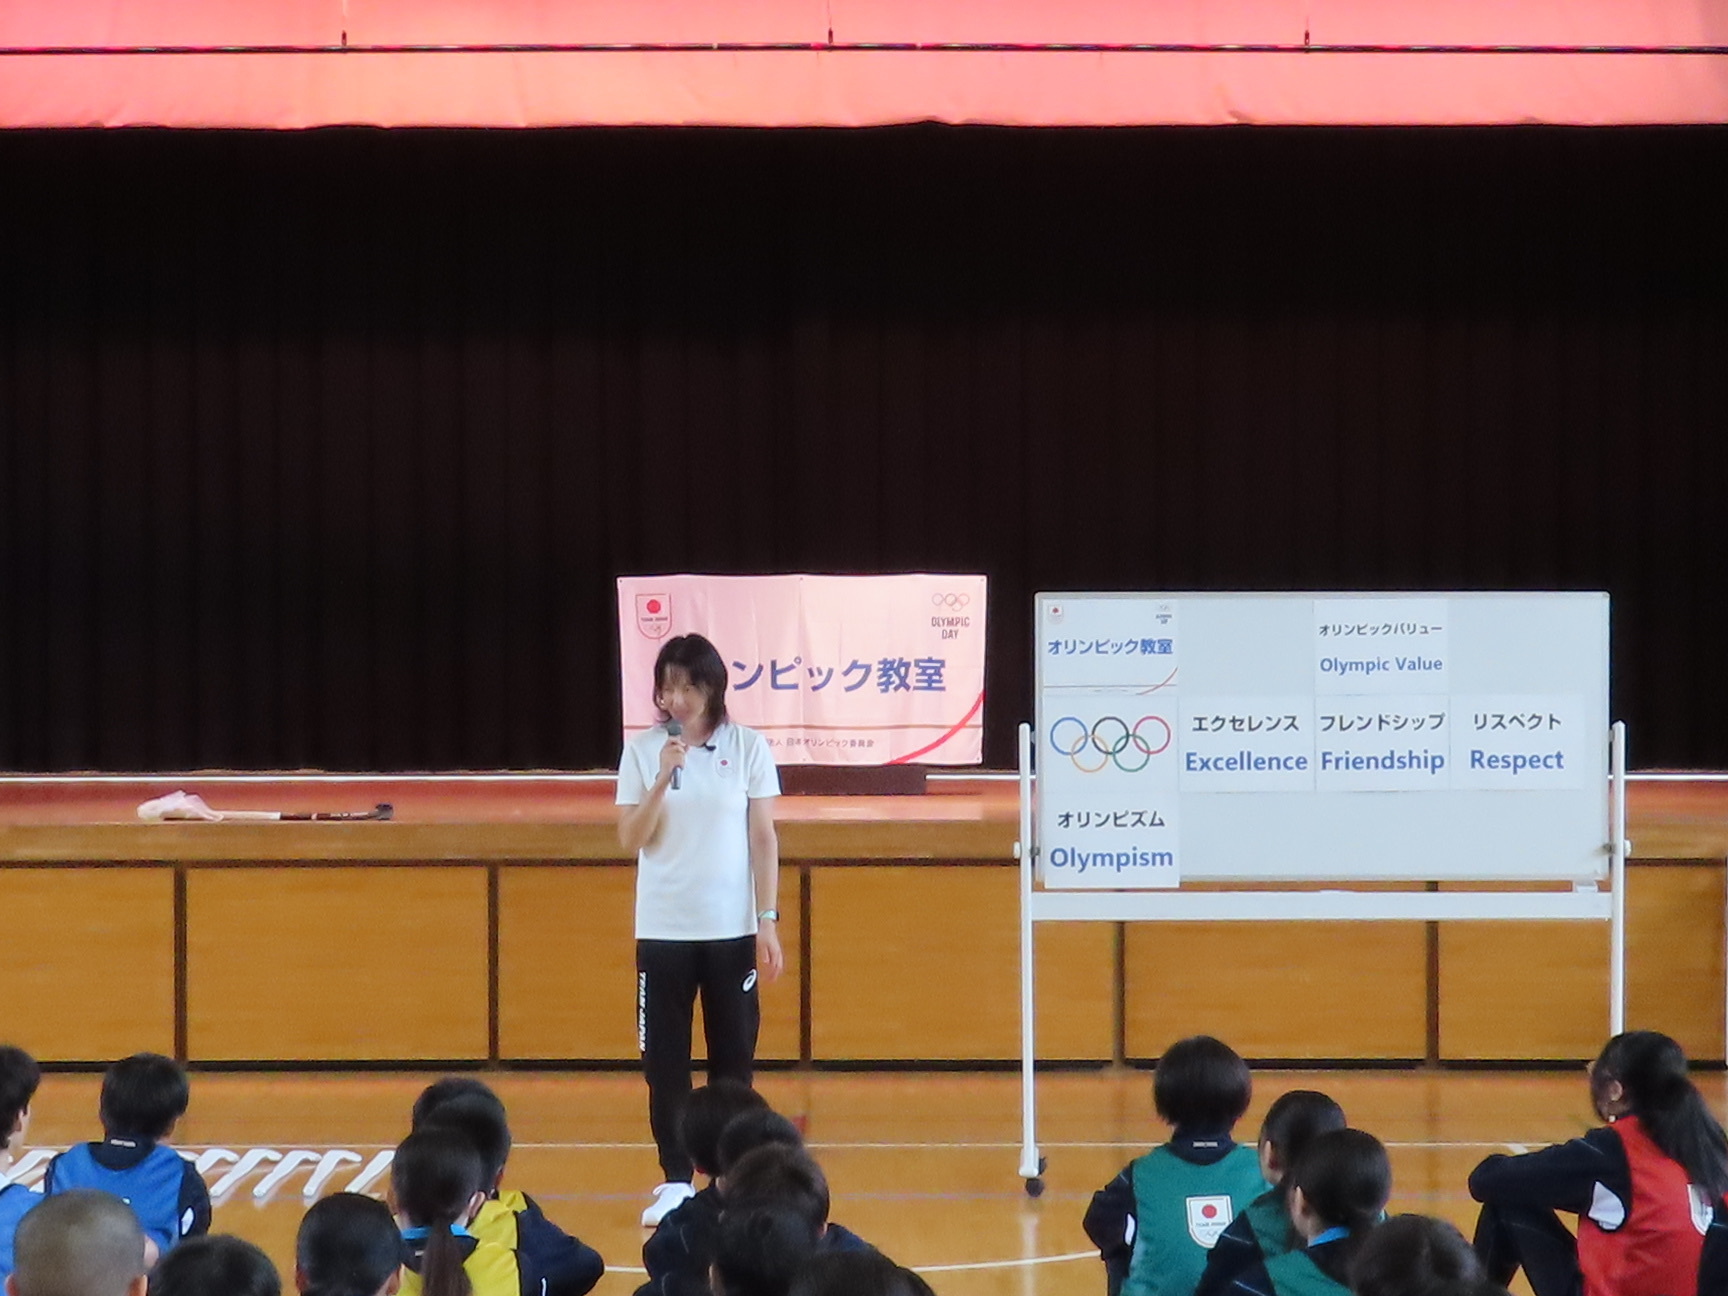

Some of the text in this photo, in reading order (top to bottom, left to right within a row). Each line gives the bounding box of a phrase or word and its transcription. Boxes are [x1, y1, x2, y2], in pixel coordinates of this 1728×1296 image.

[931, 616, 970, 628] OLYMPIC
[1319, 623, 1443, 637] オリンピックバリュー
[941, 629, 959, 640] DAY
[1048, 638, 1173, 655] オリンピック教室
[1320, 656, 1443, 676] Olympic Value
[1192, 715, 1299, 732] エクセレンス
[1320, 713, 1446, 732] フレンドシップ
[1474, 713, 1562, 730] リスペクト
[1186, 751, 1308, 772] Excellence
[1321, 750, 1445, 775] Friendship
[1470, 750, 1565, 775] Respect
[1057, 810, 1166, 829] オリンピズム
[1050, 846, 1174, 874] Olympism
